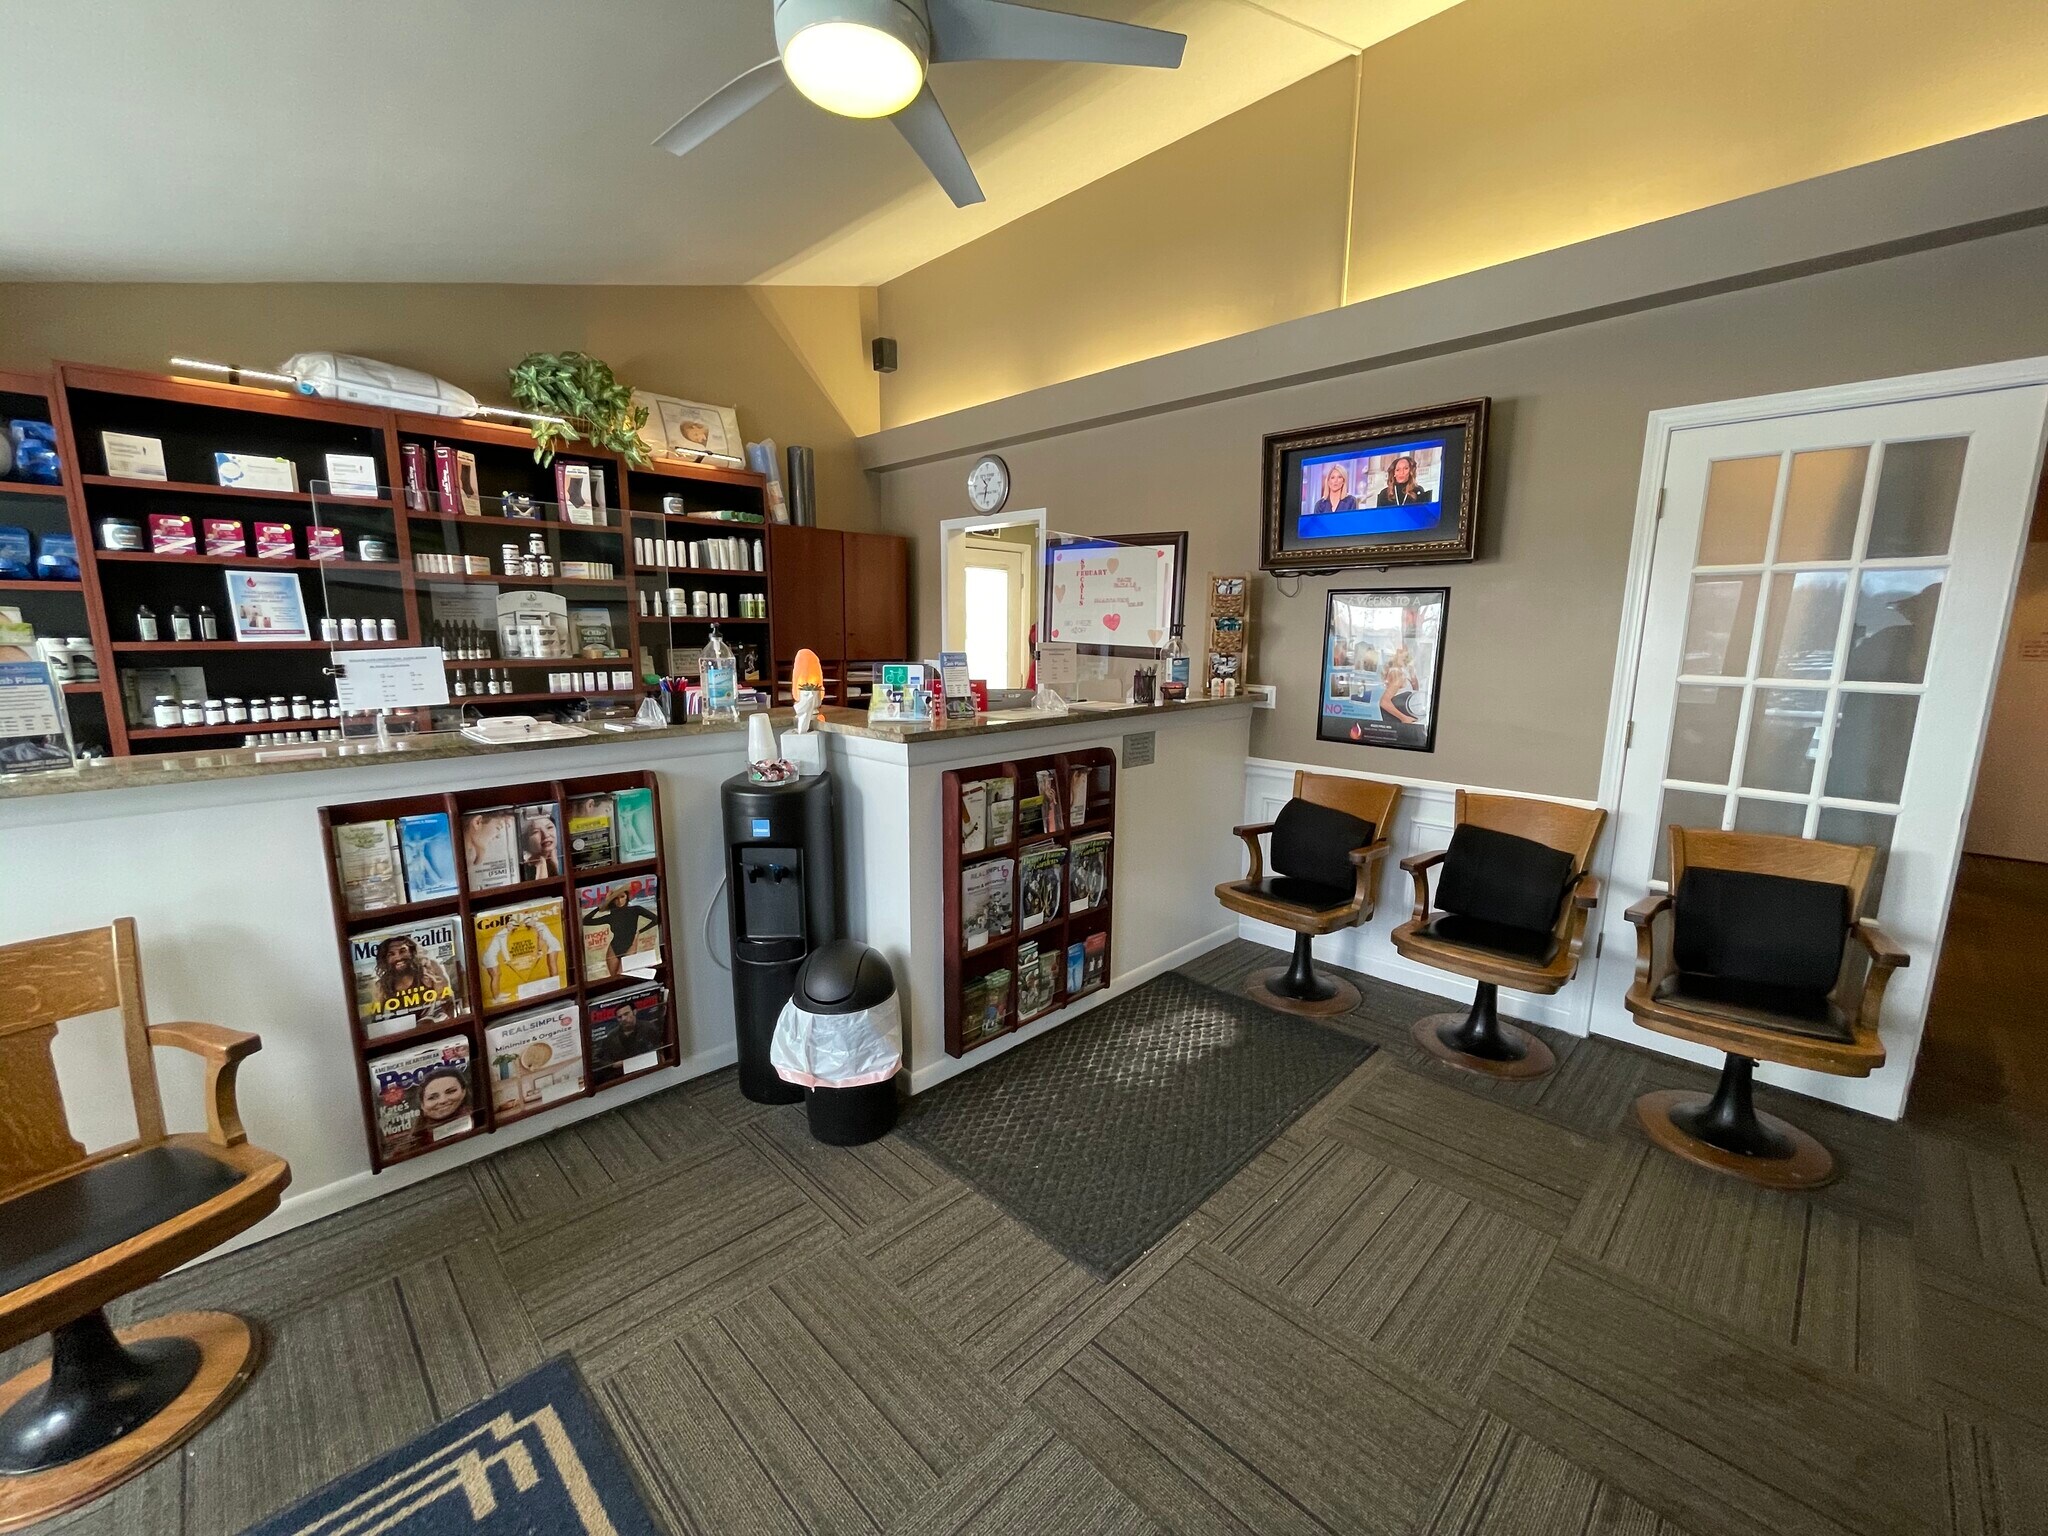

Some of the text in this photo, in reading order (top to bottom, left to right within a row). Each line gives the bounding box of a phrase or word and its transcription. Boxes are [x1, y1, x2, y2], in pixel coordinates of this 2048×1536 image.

[1357, 596, 1392, 607] WEEKS
[1395, 596, 1410, 606] TO
[1413, 597, 1421, 606] A
[15, 676, 44, 685] Plans
[1325, 703, 1342, 715] NO
[581, 878, 656, 909] SHPE
[477, 914, 512, 930] Golf
[585, 928, 609, 940] mood
[588, 937, 607, 947] shift
[397, 986, 425, 997] JASON
[362, 986, 454, 1015] MOMOA
[495, 1039, 530, 1053] Minimize
[538, 1026, 572, 1040] Organize
[382, 1118, 412, 1137] World
